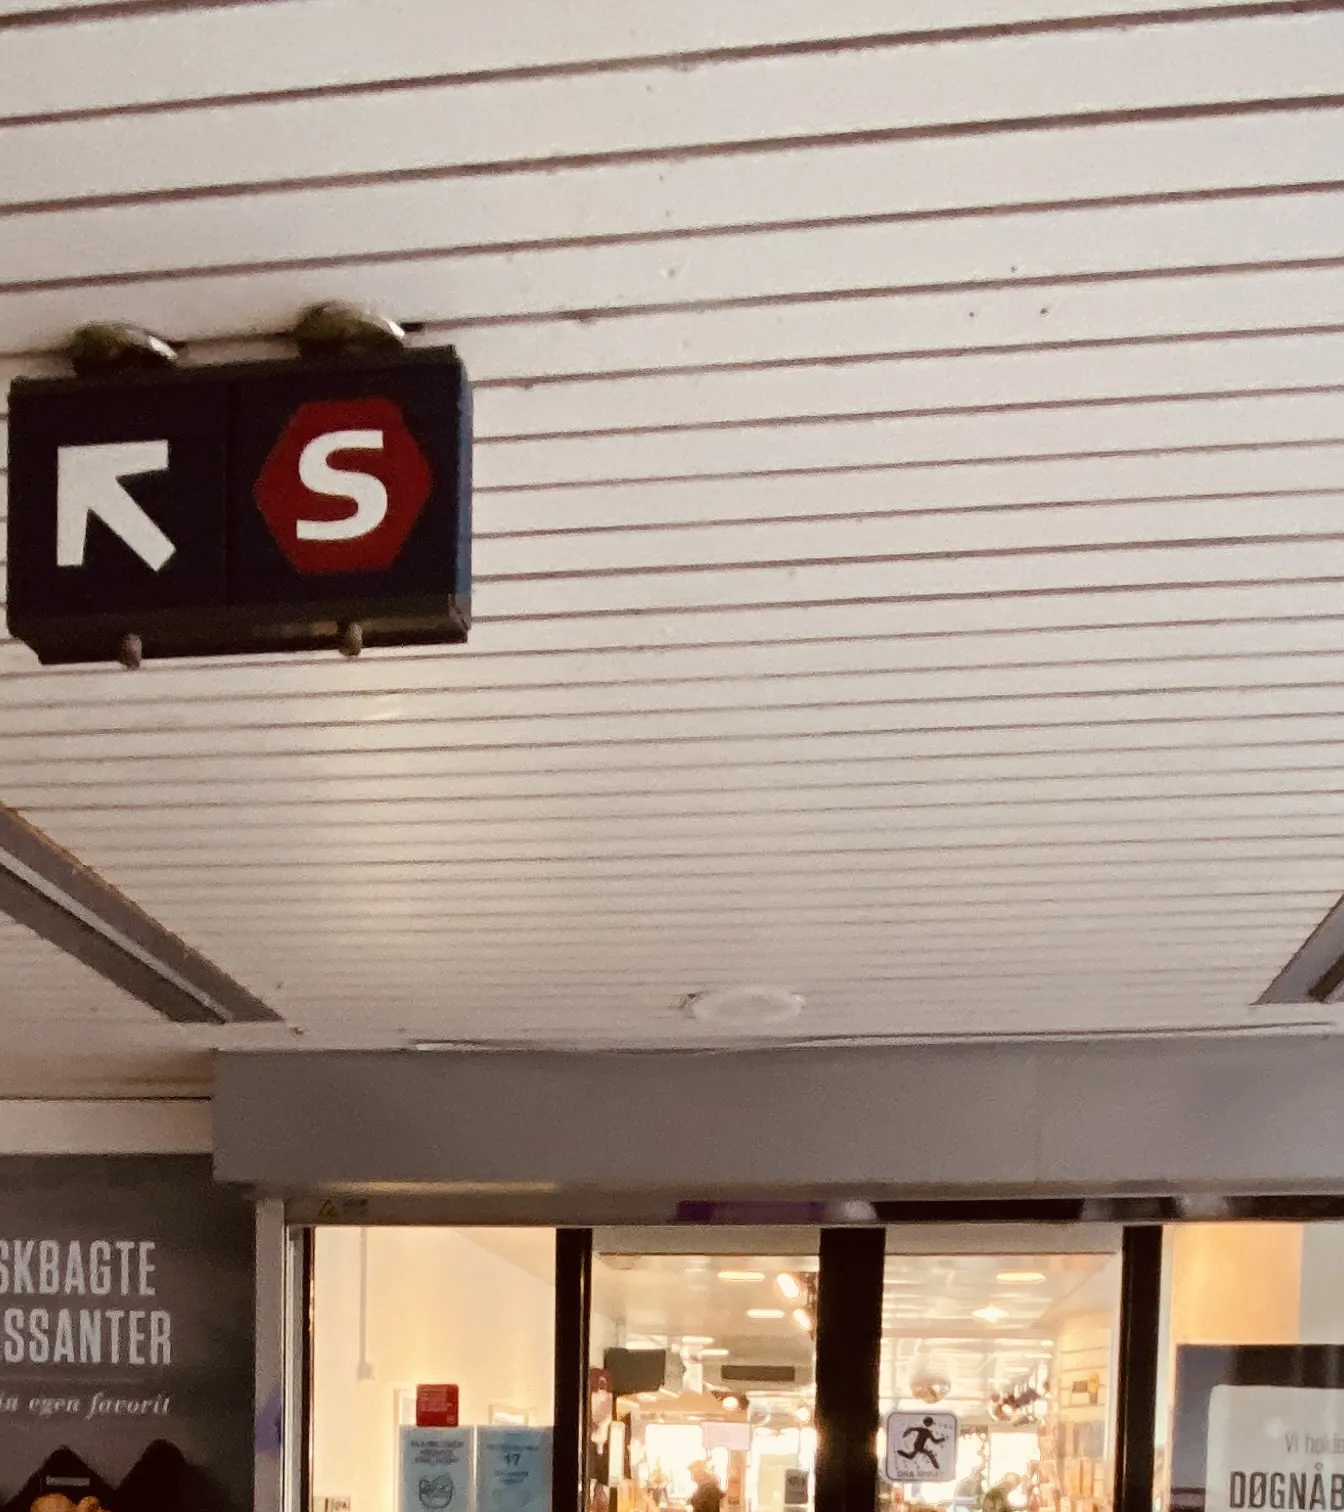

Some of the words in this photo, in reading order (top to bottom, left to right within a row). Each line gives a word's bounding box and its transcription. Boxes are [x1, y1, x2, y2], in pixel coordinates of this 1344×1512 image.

[295, 428, 389, 542] S
[28, 1396, 81, 1417] egen
[84, 1391, 171, 1421] favorit
